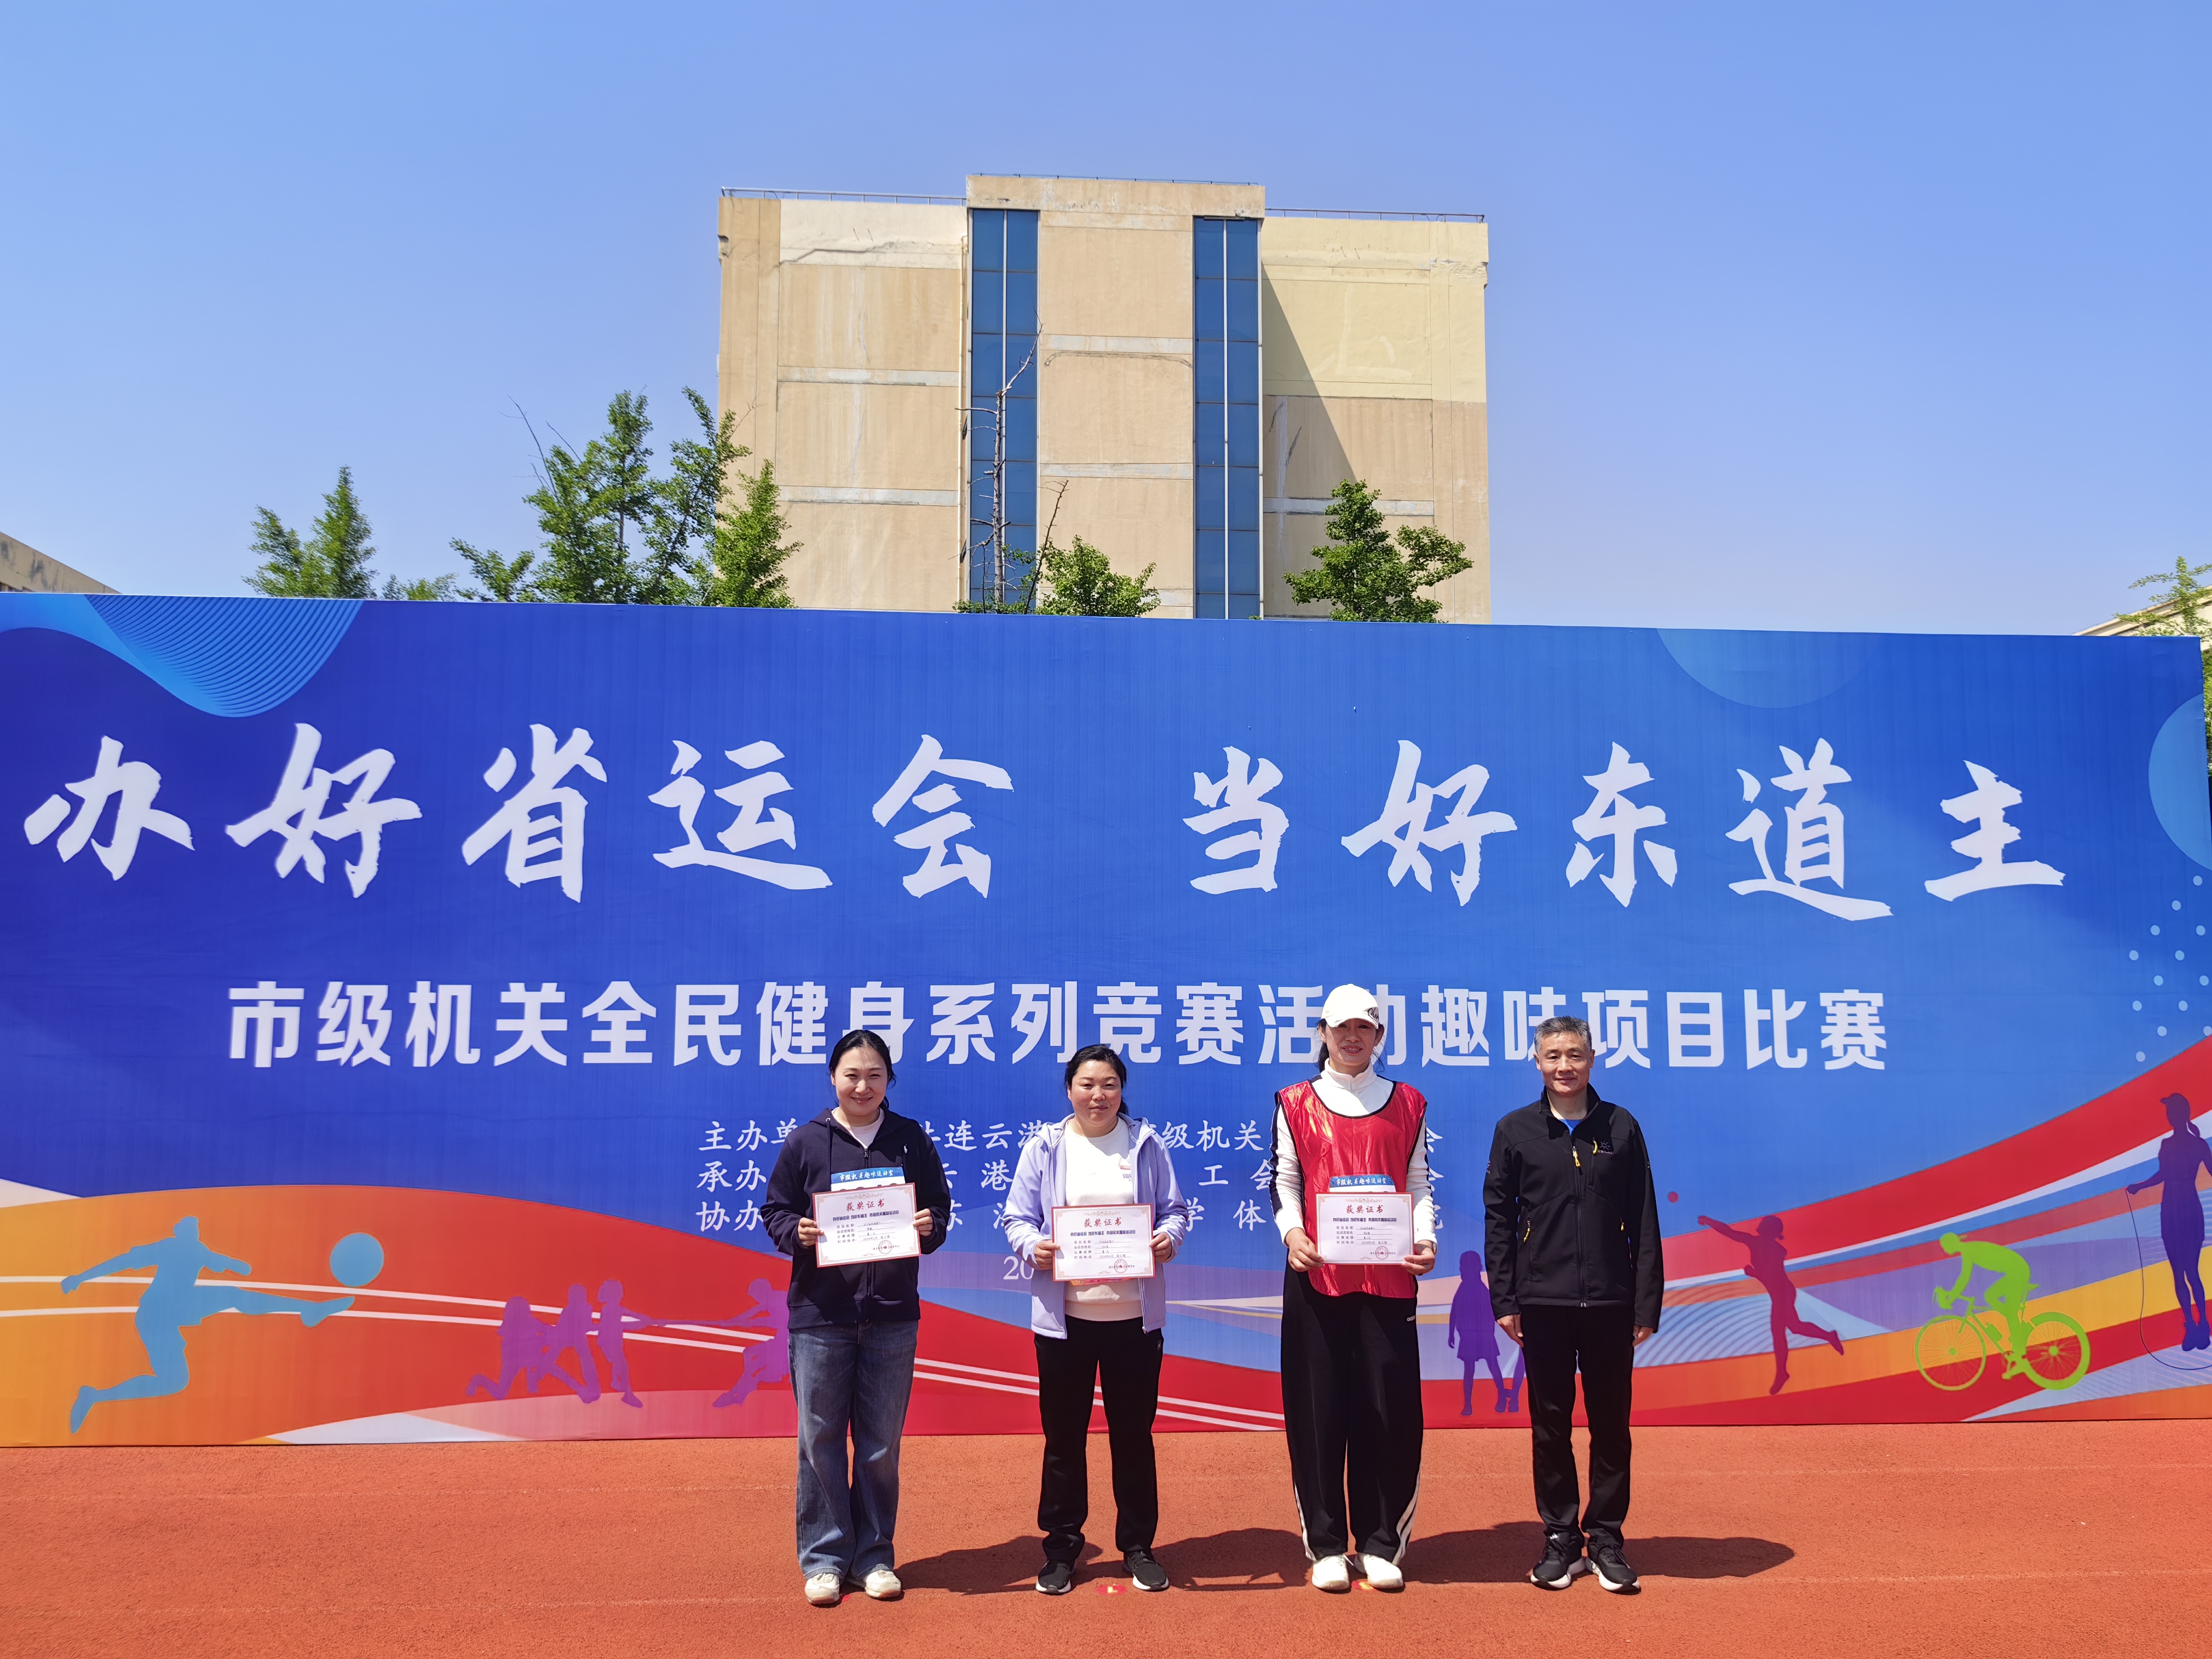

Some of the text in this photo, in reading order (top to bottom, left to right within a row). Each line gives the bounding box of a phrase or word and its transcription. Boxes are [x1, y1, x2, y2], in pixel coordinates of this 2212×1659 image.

[24, 723, 2066, 921] 办好省运会 当好东道主
[846, 1198, 885, 1212] 获奖证书
[1346, 1204, 1383, 1214] 获奖证书
[1084, 1217, 1122, 1228] 获奖证书
